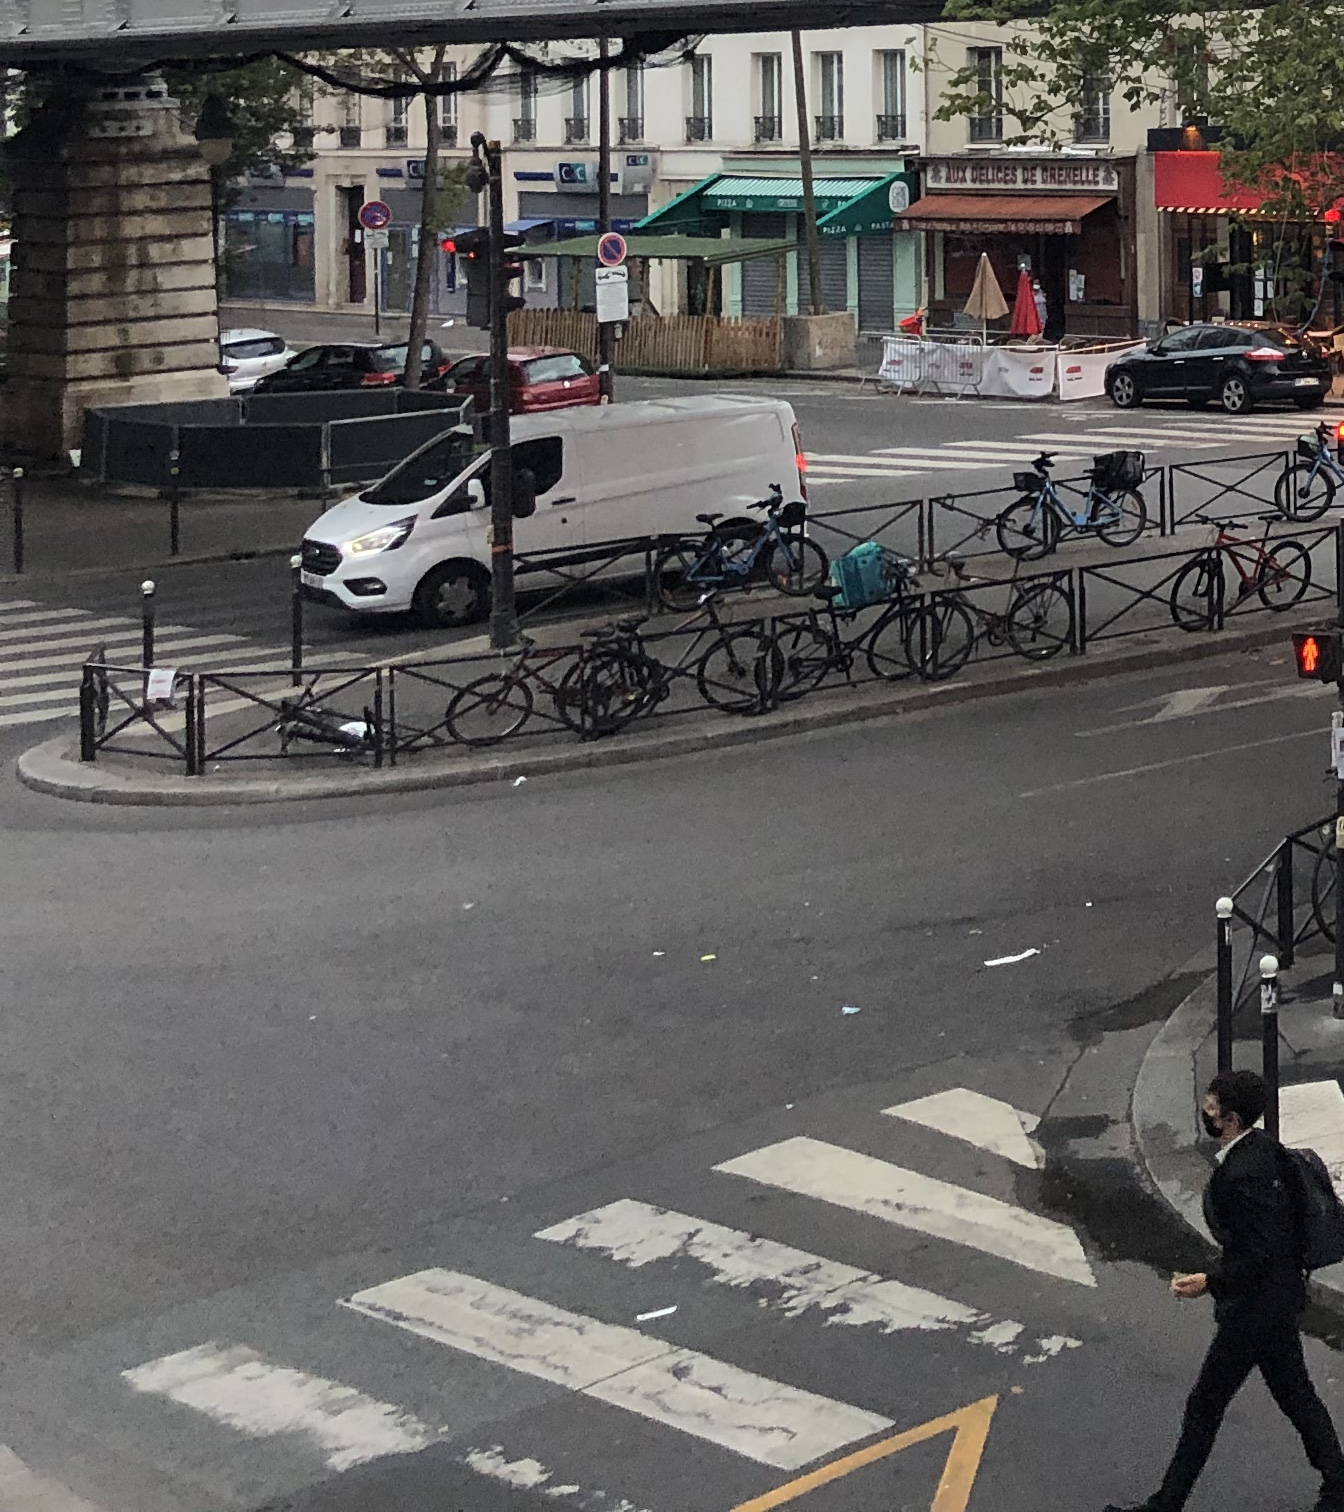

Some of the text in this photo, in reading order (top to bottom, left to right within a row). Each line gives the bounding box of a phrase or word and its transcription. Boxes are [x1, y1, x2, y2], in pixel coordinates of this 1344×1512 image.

[945, 166, 967, 184] AUX
[1021, 167, 1038, 185] DE
[717, 198, 737, 208] PIZZA
[823, 226, 847, 234] PIZZA
